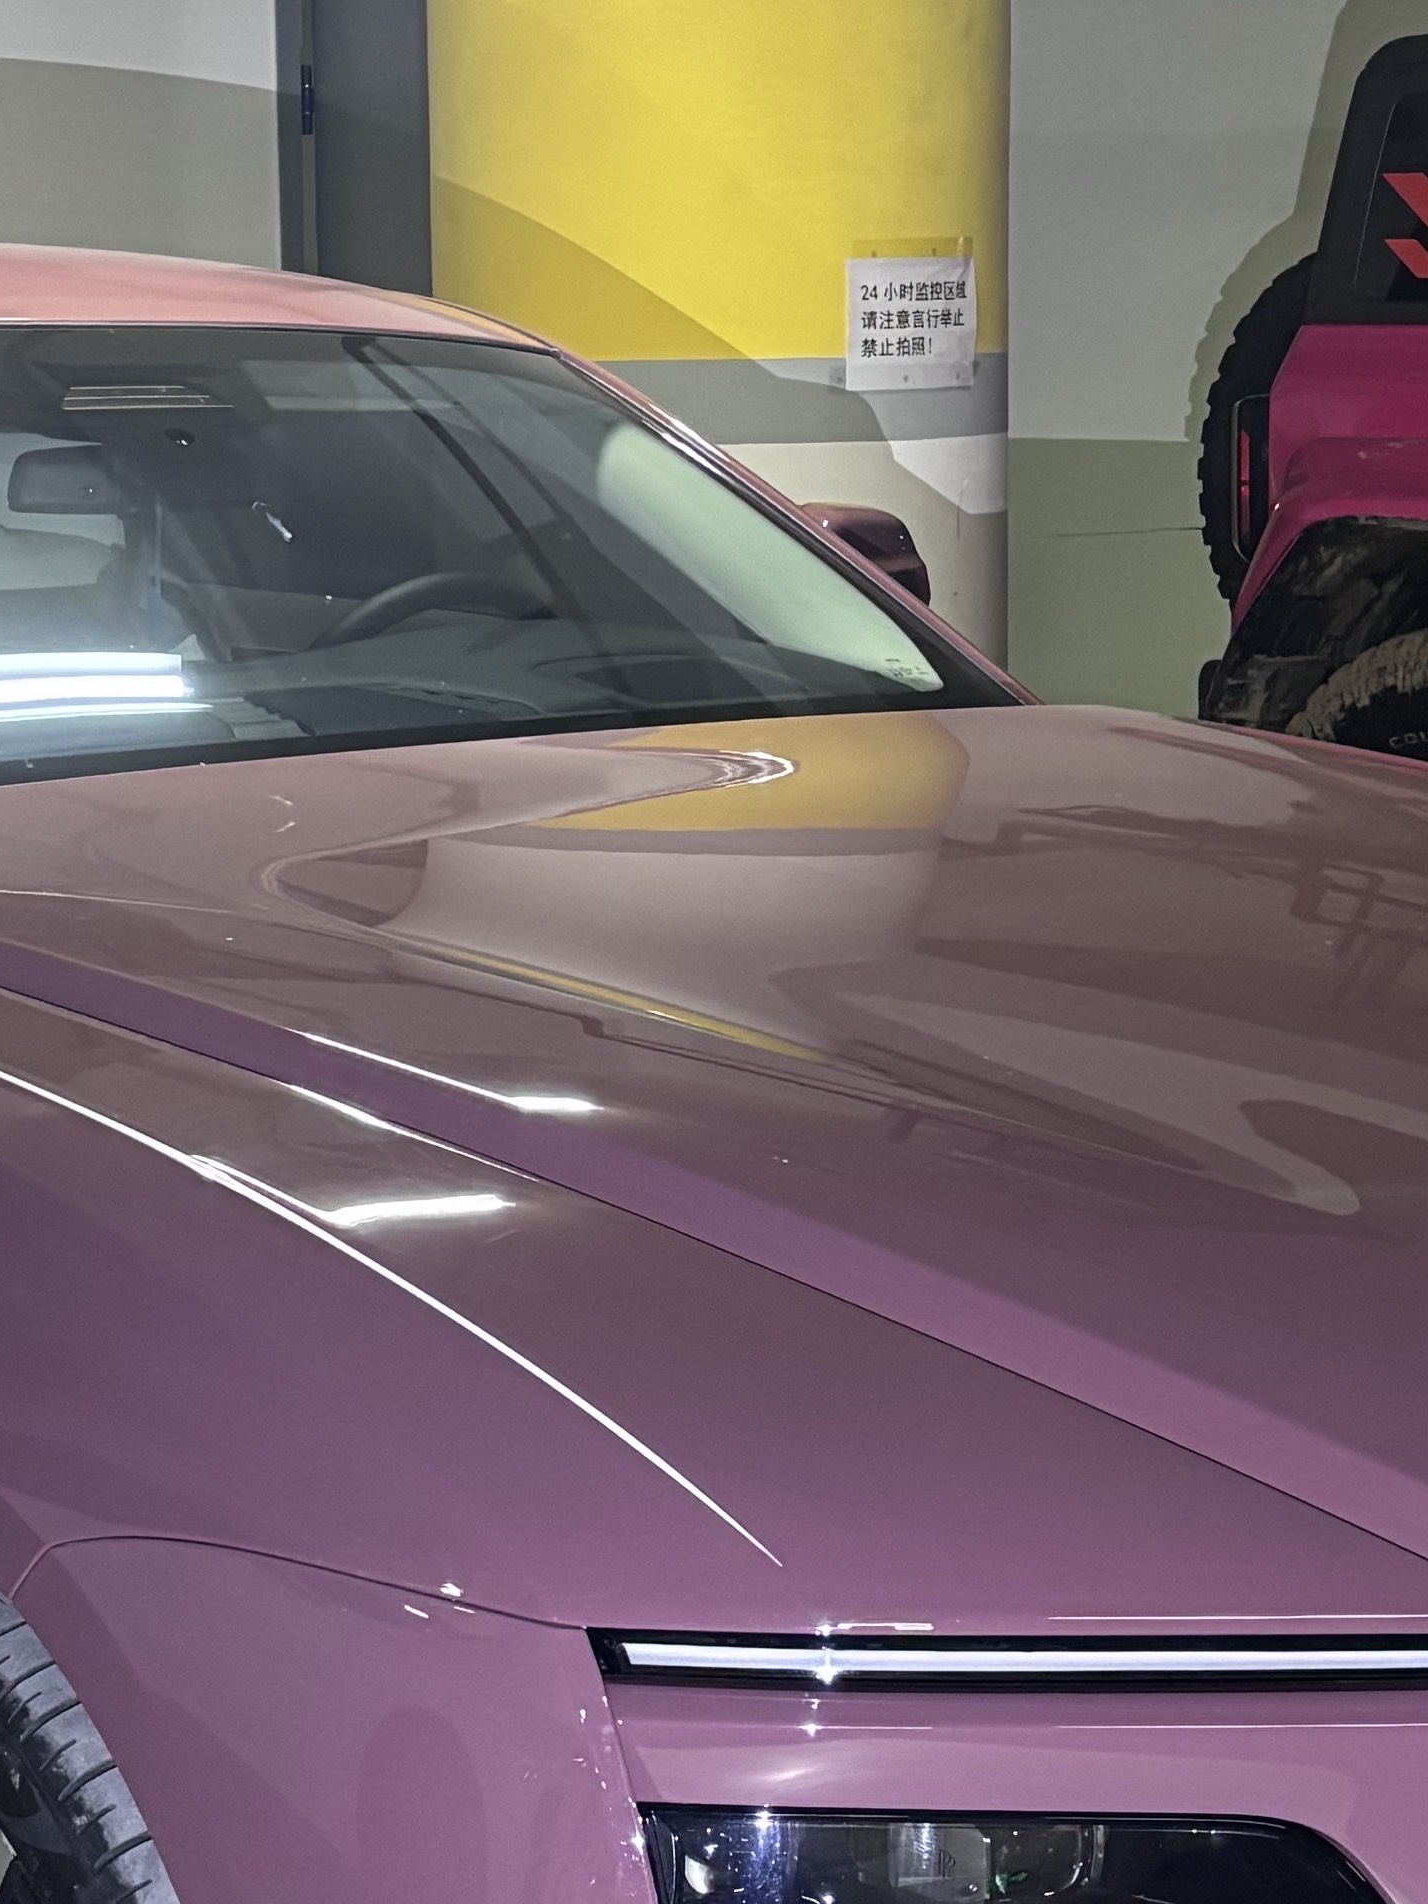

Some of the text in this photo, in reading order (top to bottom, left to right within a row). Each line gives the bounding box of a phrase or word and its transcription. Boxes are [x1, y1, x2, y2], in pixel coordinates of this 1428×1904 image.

[860, 284, 879, 302] 24
[860, 308, 966, 331] 请注意言行举止
